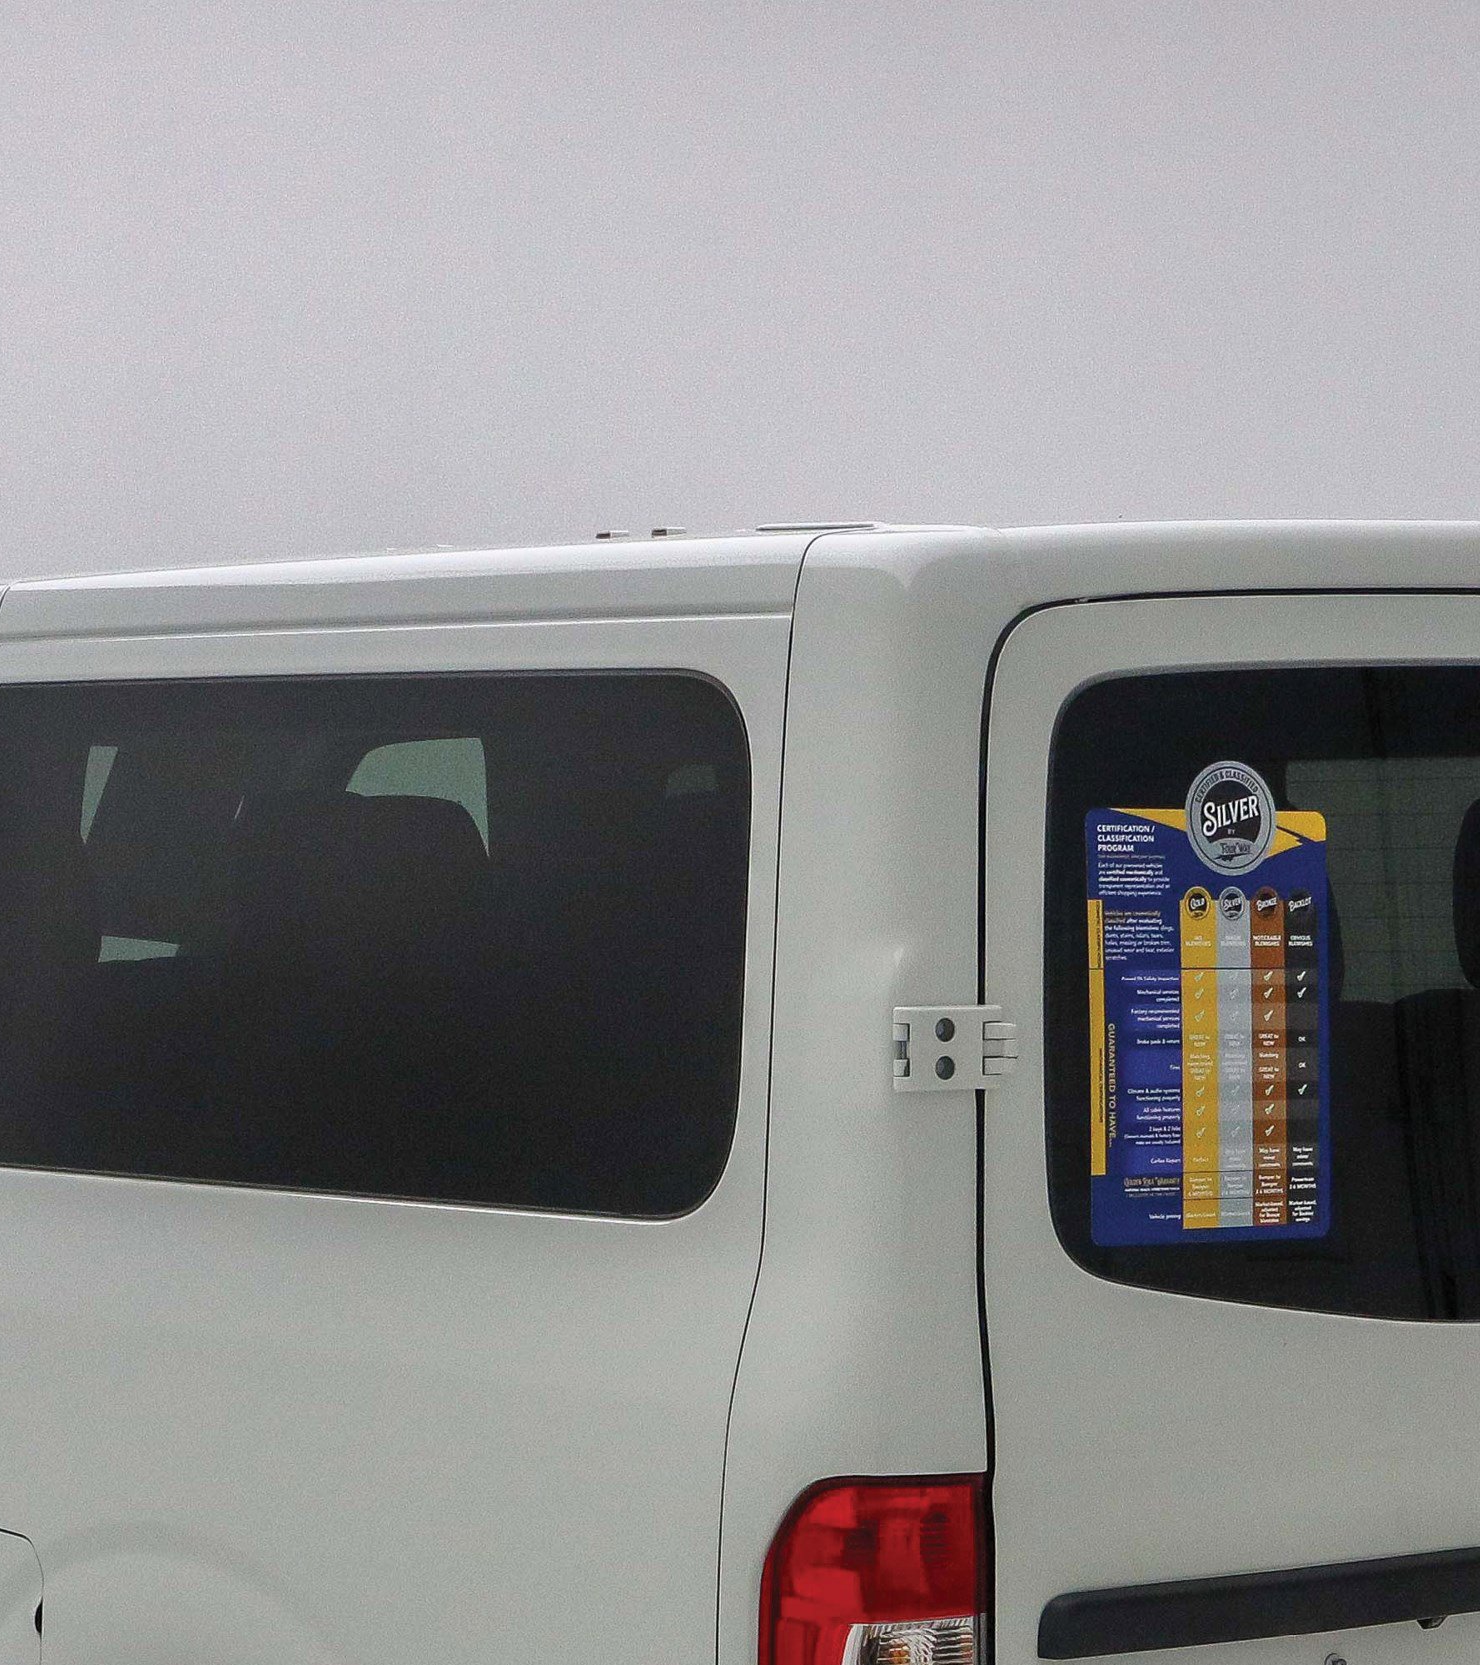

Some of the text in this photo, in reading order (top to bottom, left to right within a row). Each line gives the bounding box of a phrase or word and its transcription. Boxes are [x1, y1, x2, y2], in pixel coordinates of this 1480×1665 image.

[1224, 770, 1259, 793] CLASSIFIED
[1202, 795, 1259, 837] SILVER
[1097, 825, 1150, 833] CERTIFICATION
[1097, 834, 1155, 842] CLASSIFICATION
[1107, 1023, 1116, 1093] GUARANTEED
[1108, 1095, 1117, 1109] TO
